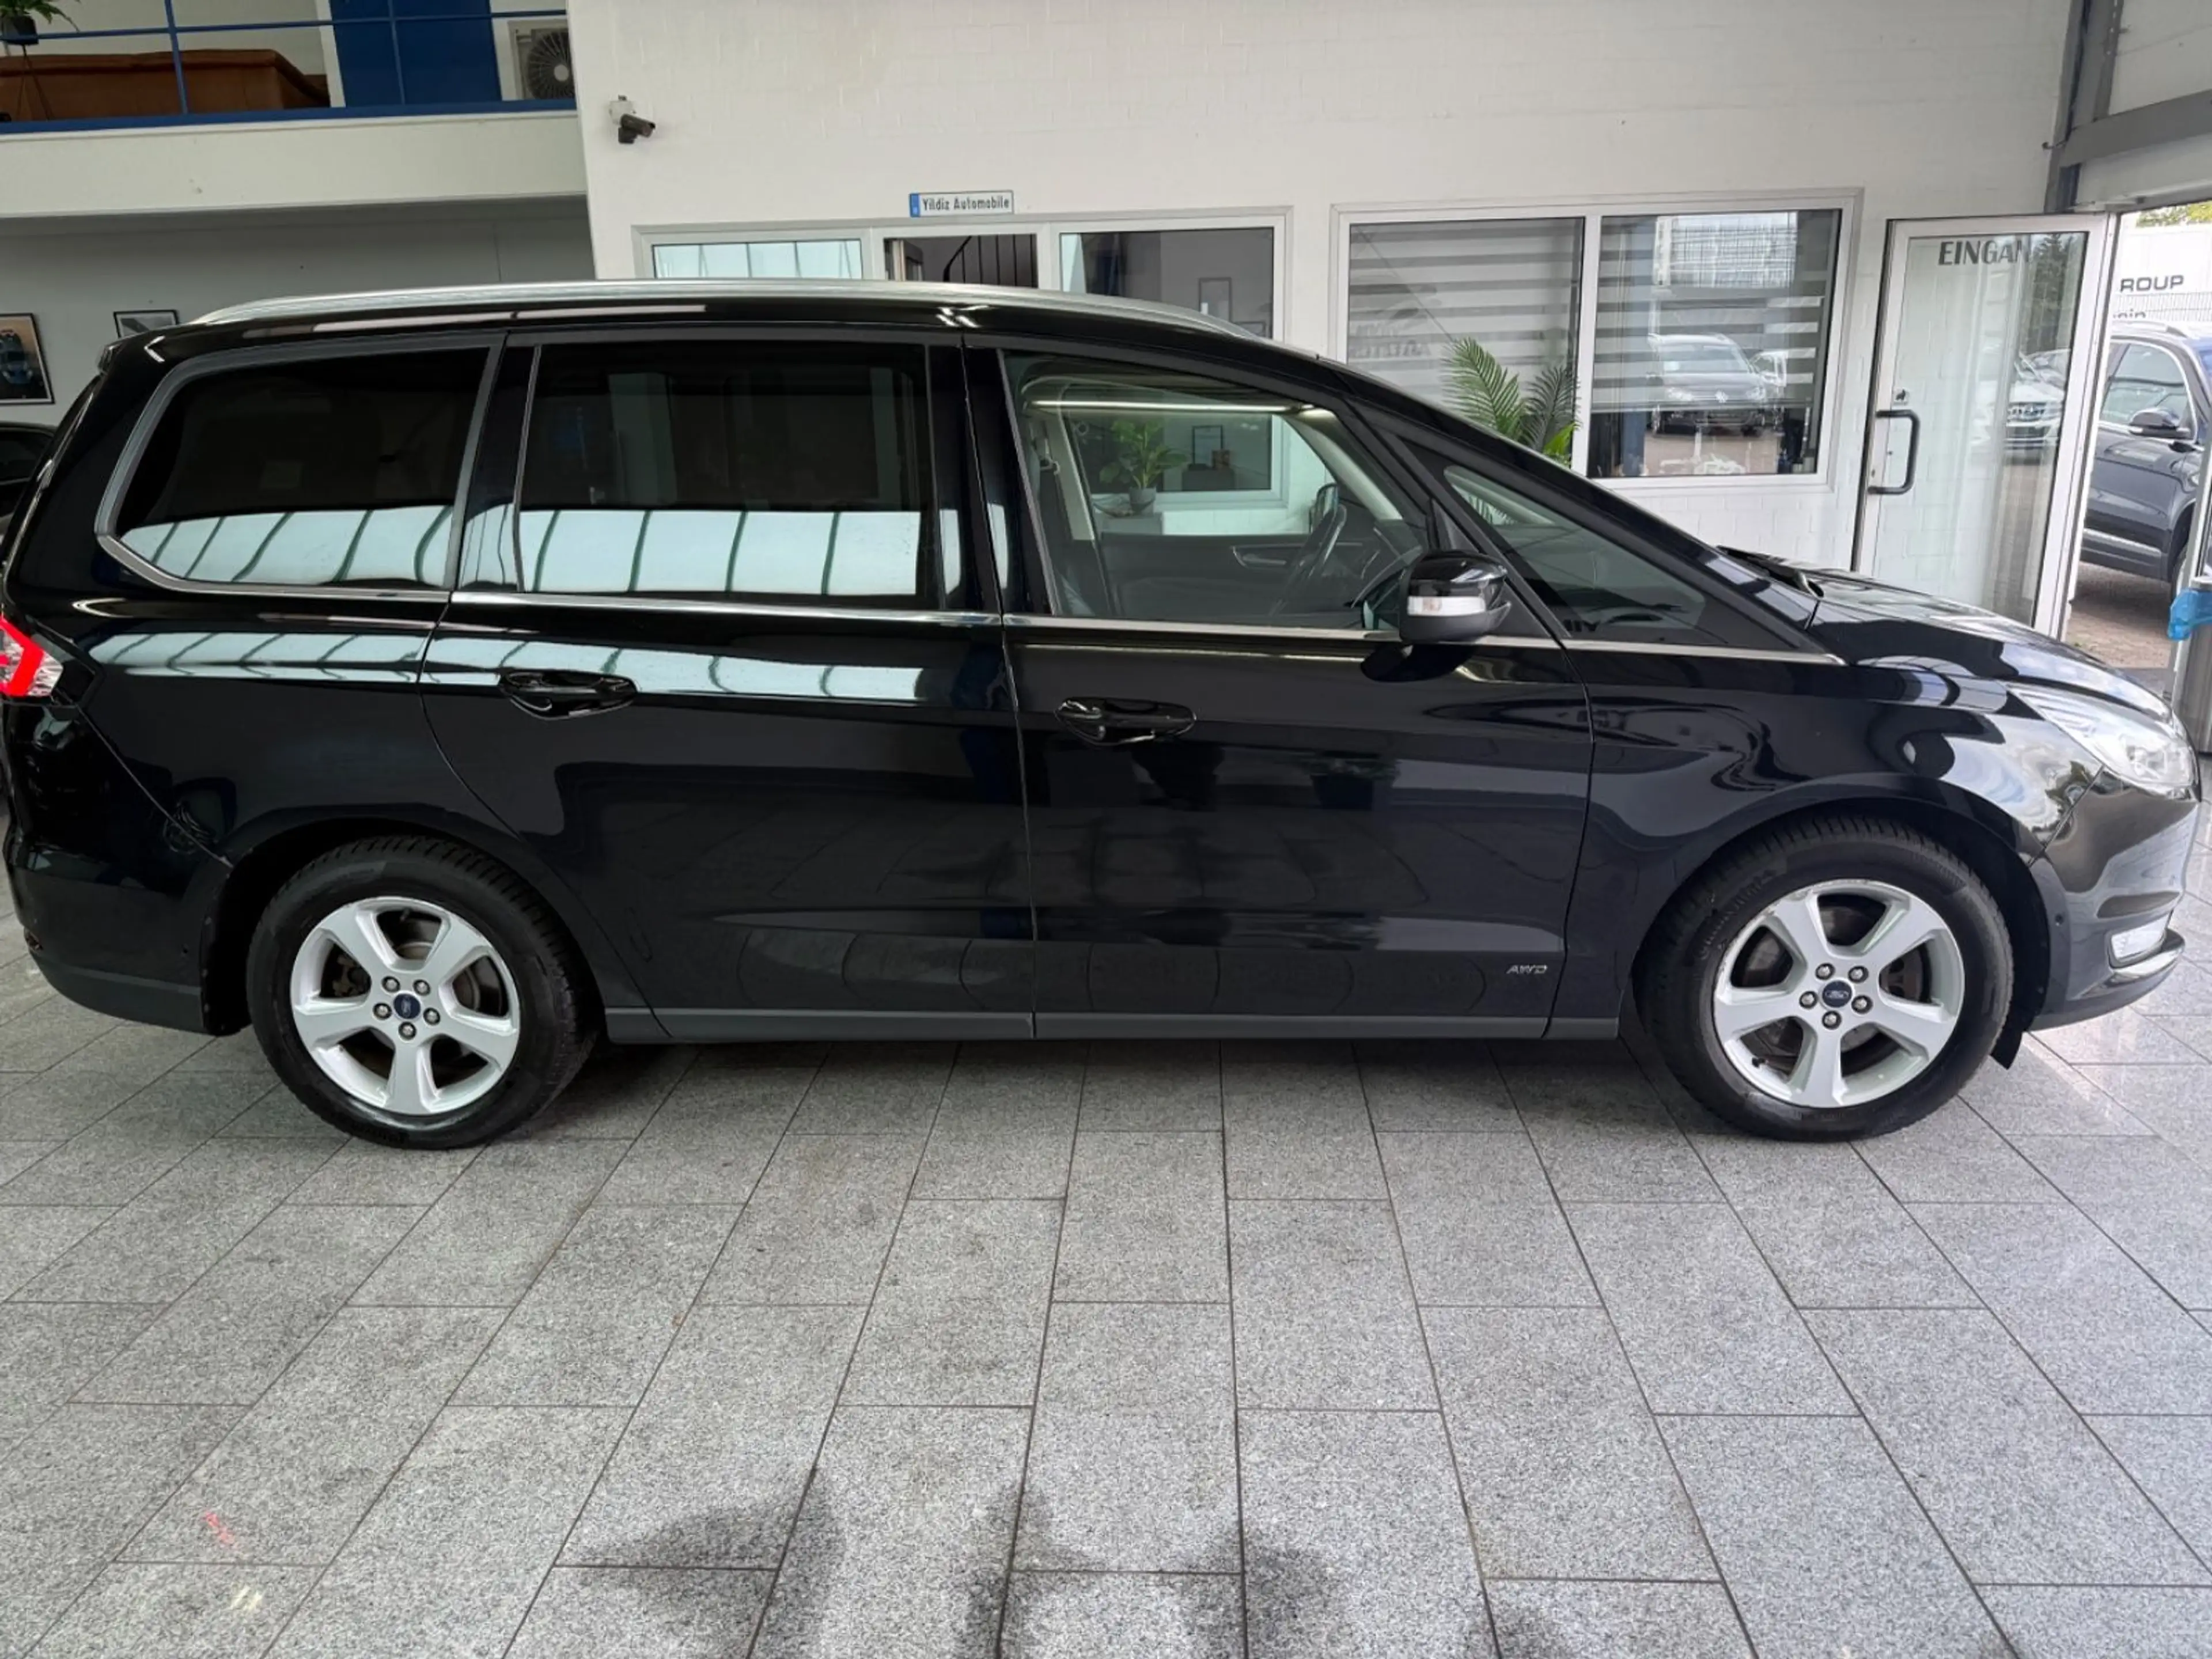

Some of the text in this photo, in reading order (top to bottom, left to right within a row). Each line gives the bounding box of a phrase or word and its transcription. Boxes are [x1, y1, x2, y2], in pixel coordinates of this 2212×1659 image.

[923, 197, 950, 211] Yildiz
[953, 195, 1010, 210] Automobile
[1505, 964, 1548, 975] AWD
